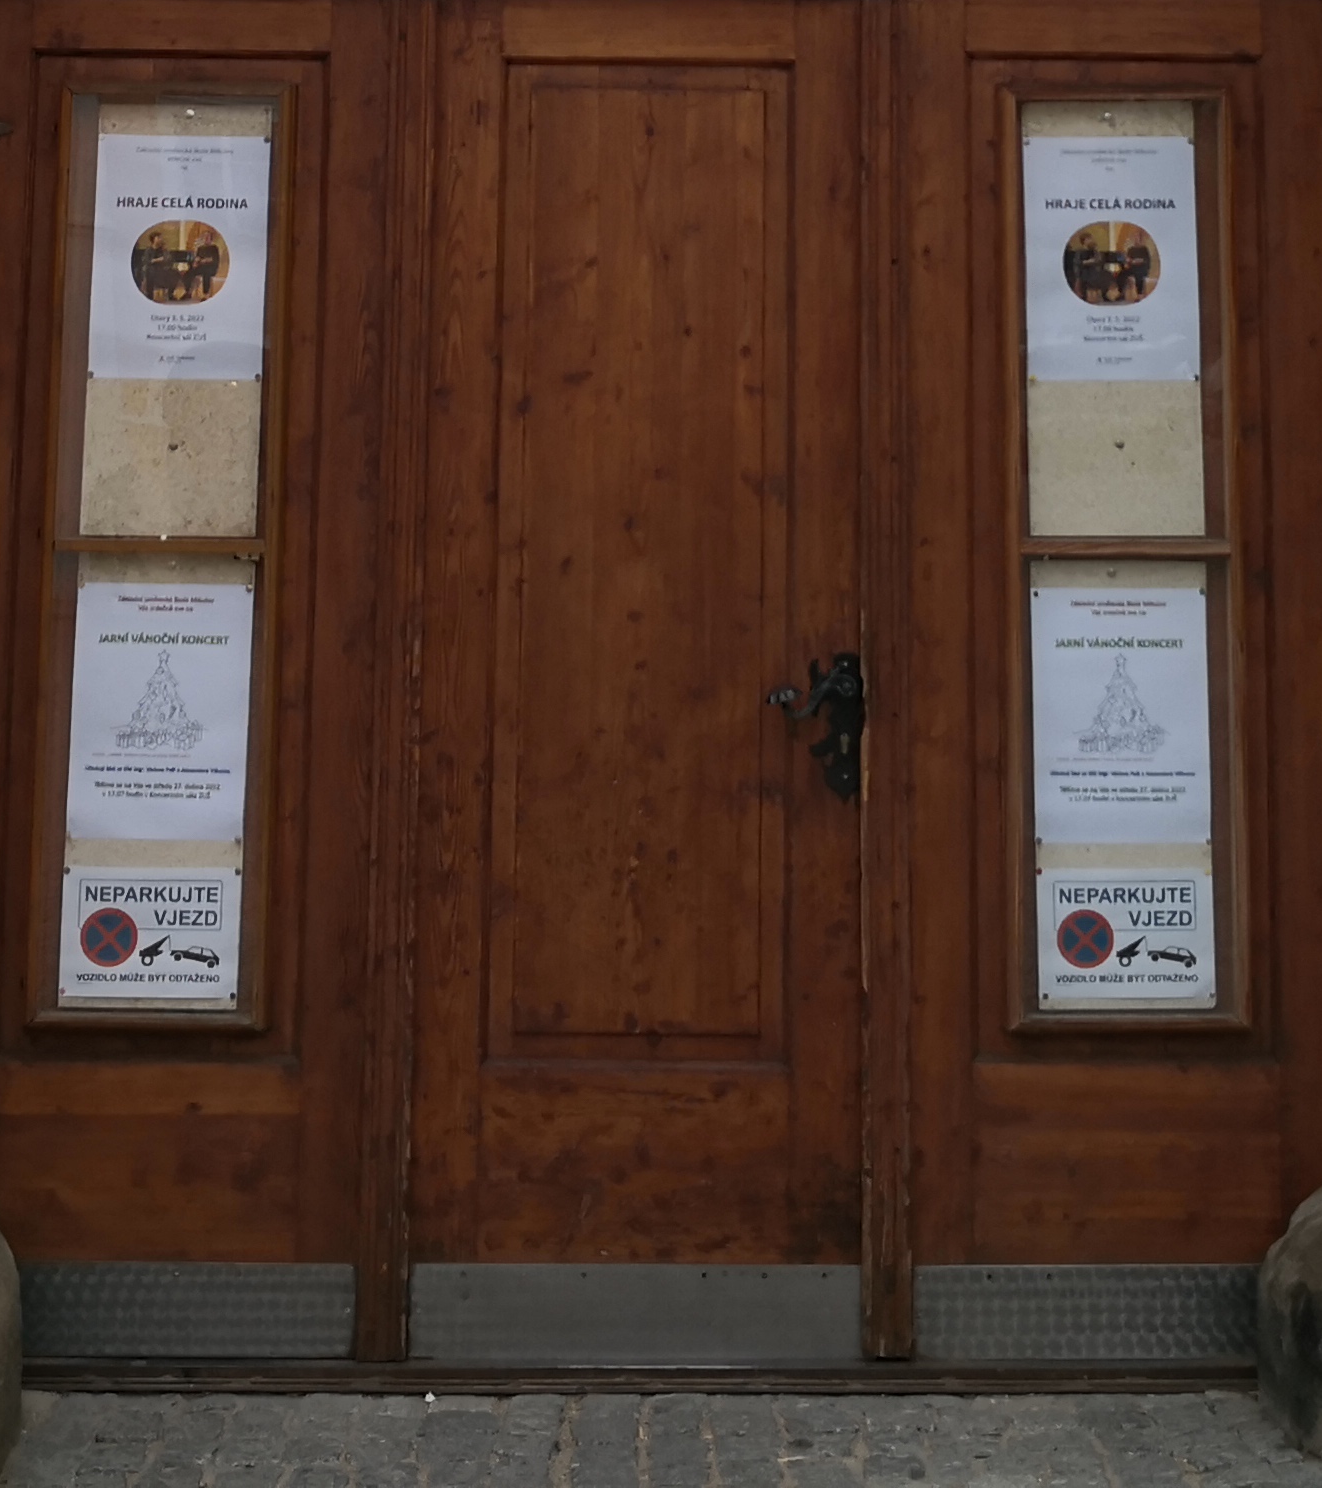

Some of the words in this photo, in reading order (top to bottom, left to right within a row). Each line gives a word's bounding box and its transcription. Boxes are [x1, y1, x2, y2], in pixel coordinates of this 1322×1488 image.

[116, 196, 159, 208] HRAJE
[161, 195, 194, 209] CELÁ
[197, 197, 248, 209] RODINA
[1045, 198, 1087, 209] HRAJE
[1089, 196, 1122, 210] CELÁ
[1124, 198, 1176, 209] RODINA
[98, 632, 129, 644] JARNÍ
[131, 632, 181, 645] VÁNOČNÍ
[181, 634, 230, 645] KONCERT
[85, 886, 219, 903] NEPARKUJTE
[1059, 887, 1192, 904] NEPARKUJTE
[154, 909, 218, 926] VJEZD
[1129, 910, 1193, 926] VJEZD
[77, 973, 117, 982] VOZIDLO
[168, 973, 220, 983] ODTAŽENO
